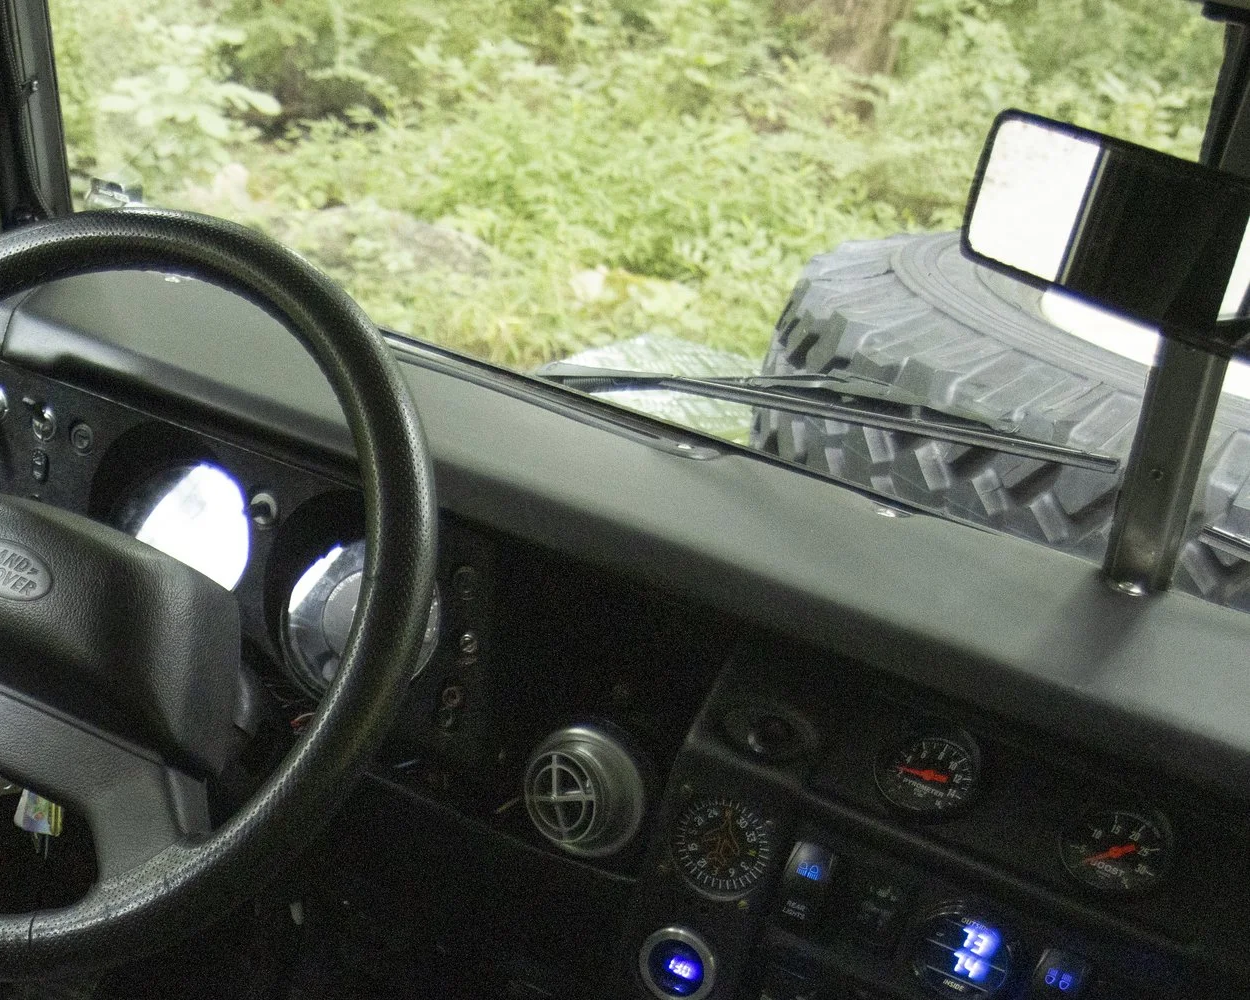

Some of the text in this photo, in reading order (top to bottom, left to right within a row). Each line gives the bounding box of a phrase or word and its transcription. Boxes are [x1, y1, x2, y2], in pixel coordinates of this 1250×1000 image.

[902, 777, 945, 798] PYROMETER
[1091, 828, 1103, 839] 10
[1110, 824, 1122, 835] 15
[782, 906, 806, 921] LIGHTS
[961, 917, 989, 931] OUTSID
[942, 978, 966, 992] INSIDE
